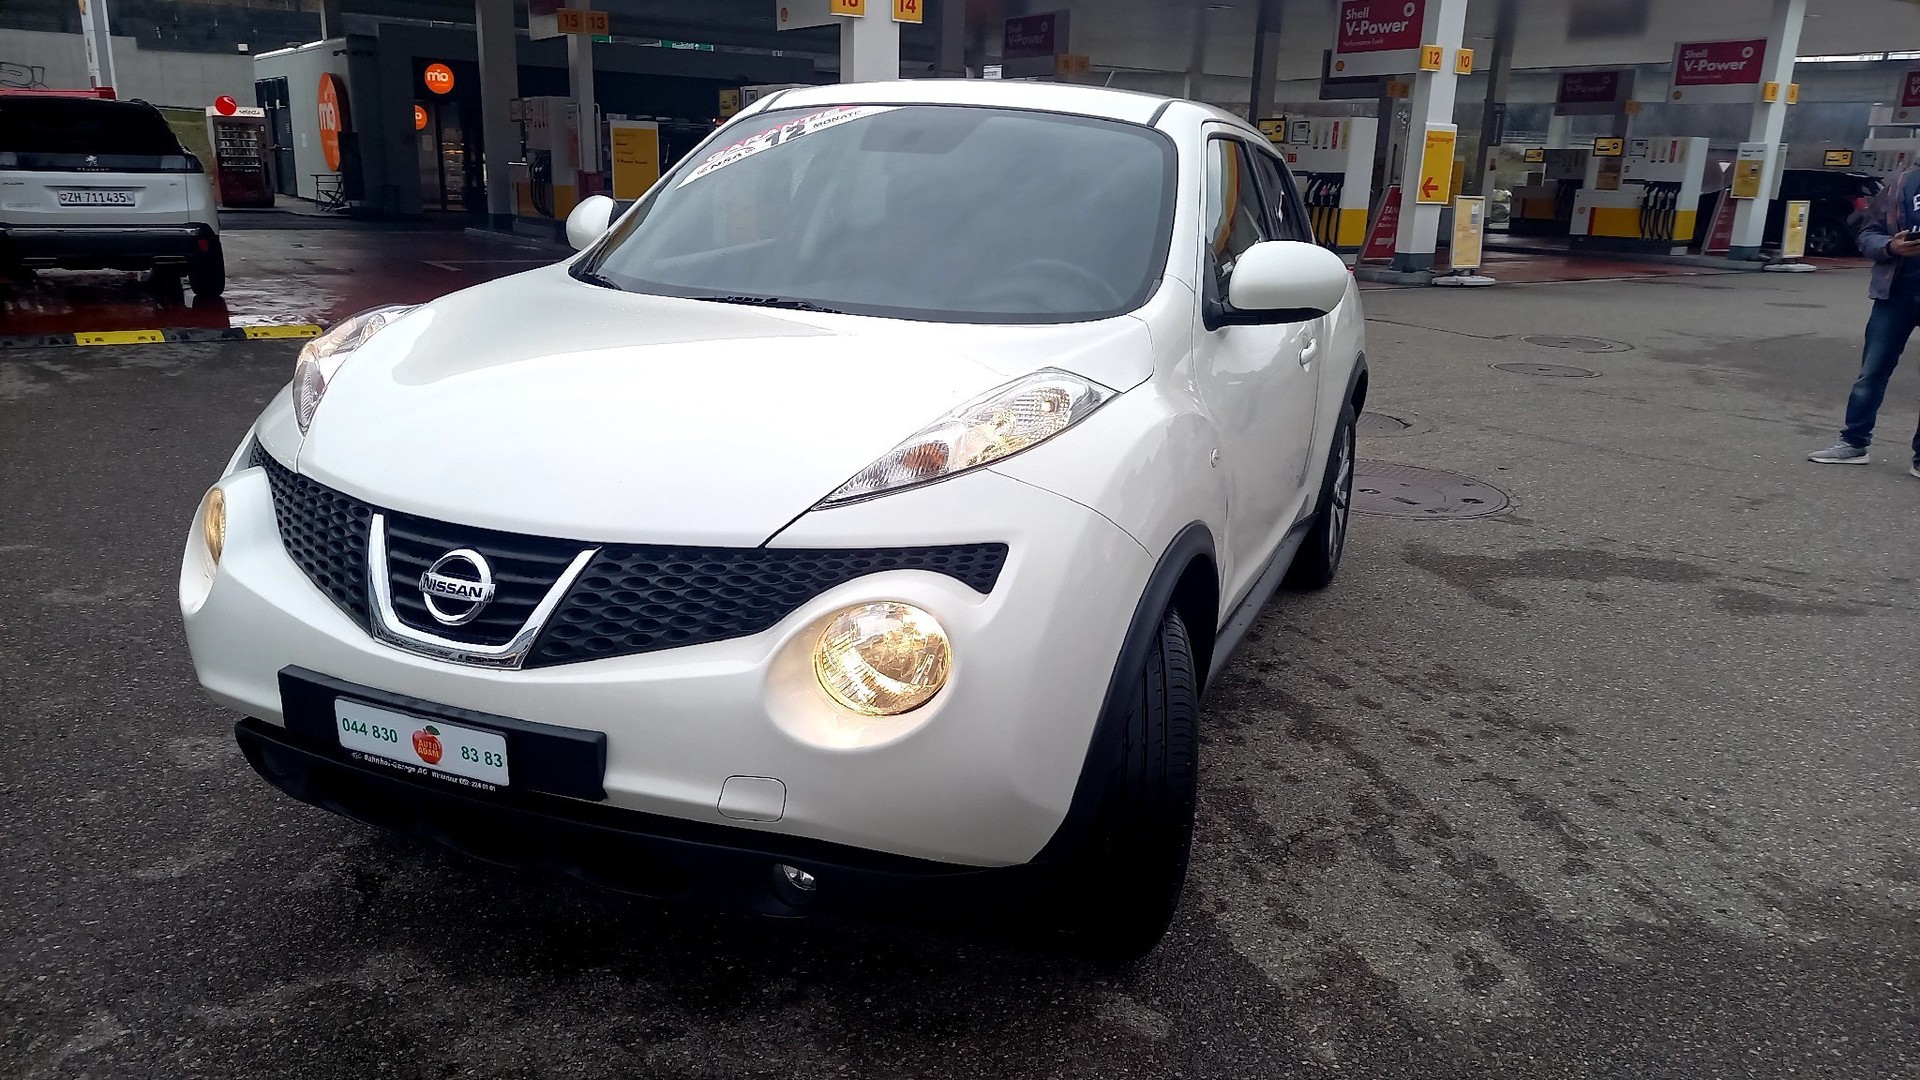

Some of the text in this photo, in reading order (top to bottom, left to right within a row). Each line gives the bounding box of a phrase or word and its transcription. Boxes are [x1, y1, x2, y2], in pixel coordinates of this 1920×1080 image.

[899, 0, 917, 13] 14
[1345, 6, 1370, 20] Shell
[563, 14, 605, 30] 15 13
[1345, 20, 1409, 36] V-Power
[1428, 51, 1440, 65] 12
[1684, 49, 1708, 59] Shell
[1460, 55, 1470, 68] 10
[1684, 59, 1747, 72] V-Power
[426, 69, 449, 82] mio
[765, 123, 806, 146] 12
[424, 575, 484, 598] NISSAN
[341, 717, 503, 768] 044 830 83 83
[417, 739, 439, 751] AUTO
[417, 747, 439, 758] ADAM
